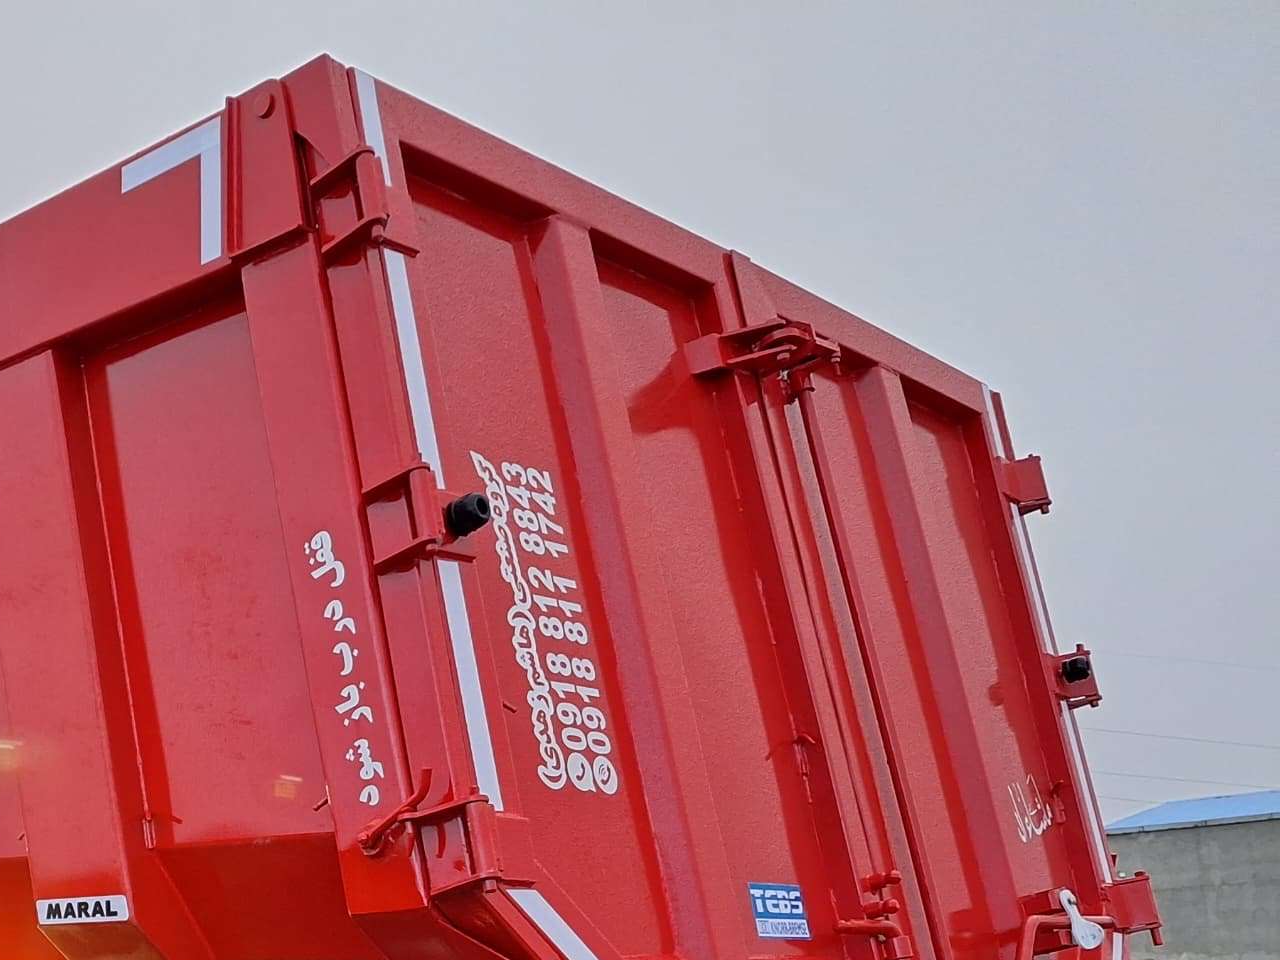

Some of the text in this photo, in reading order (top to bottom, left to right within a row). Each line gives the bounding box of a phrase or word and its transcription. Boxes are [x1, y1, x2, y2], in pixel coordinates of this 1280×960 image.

[304, 531, 345, 587] قفل
[501, 462, 587, 751] 0918 812 8843
[526, 467, 611, 755] 0918 811 1742
[335, 681, 373, 727] باز
[345, 738, 384, 806] شود
[45, 898, 118, 920] MARAL
